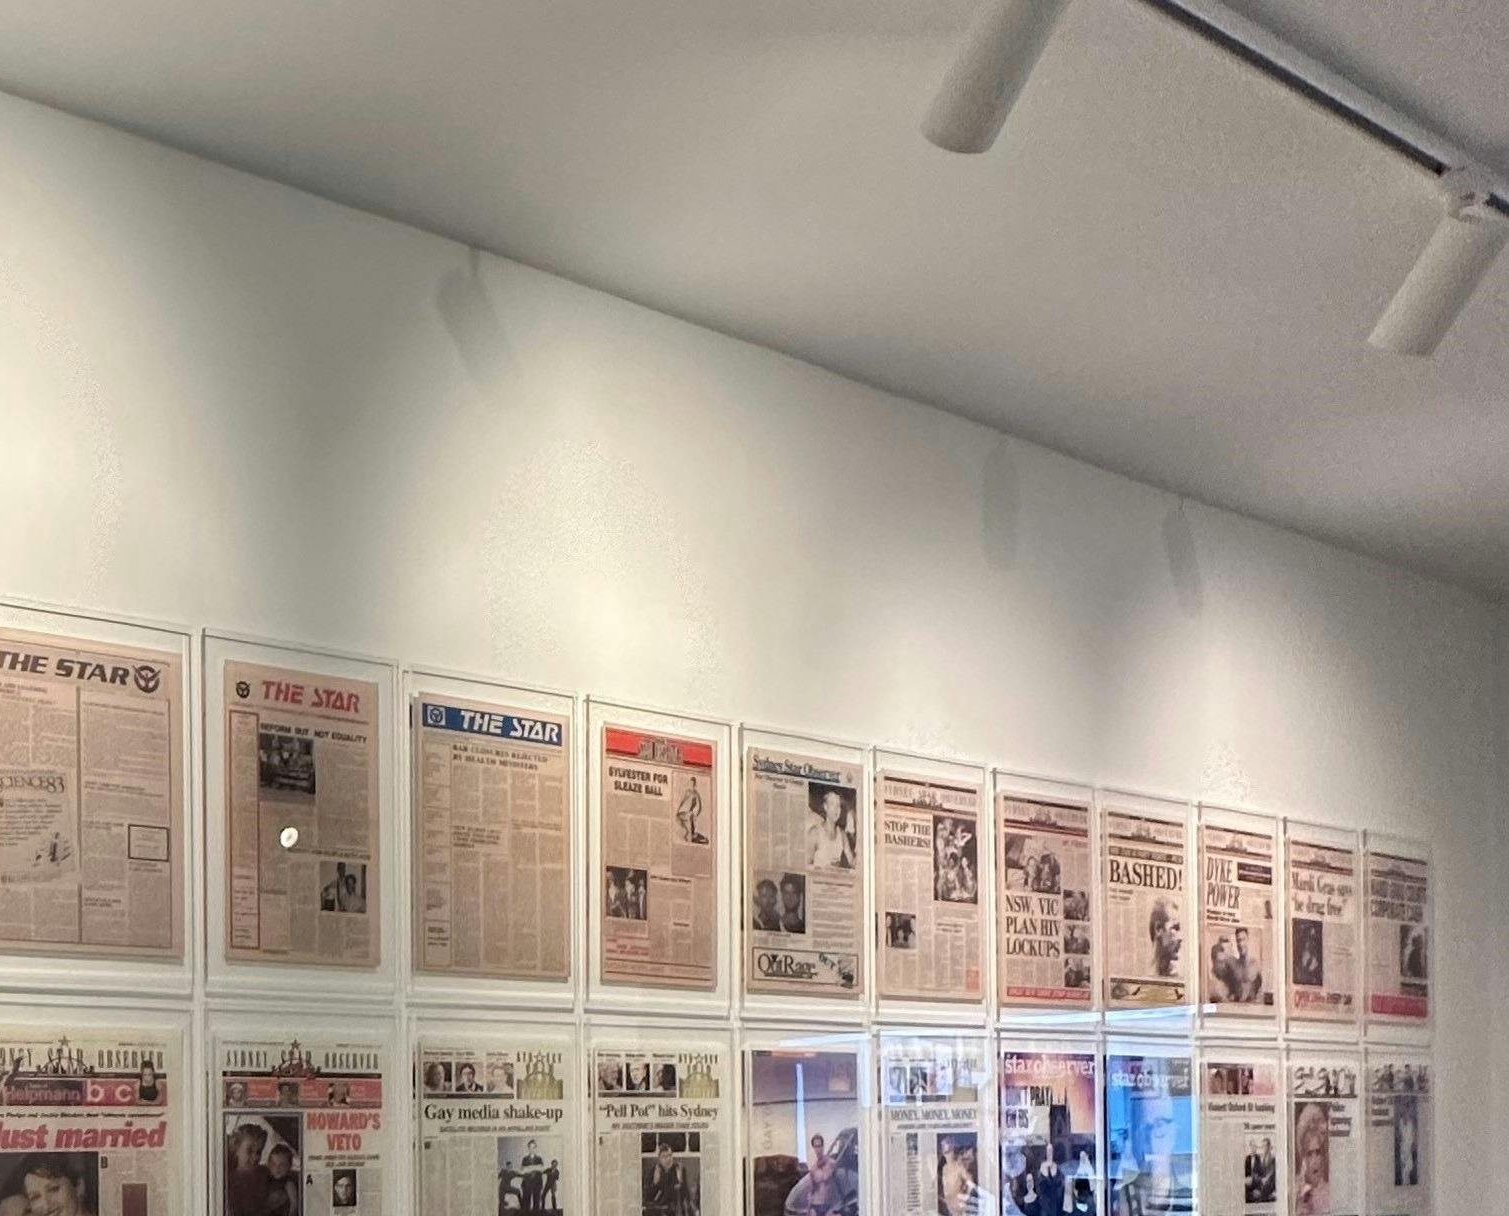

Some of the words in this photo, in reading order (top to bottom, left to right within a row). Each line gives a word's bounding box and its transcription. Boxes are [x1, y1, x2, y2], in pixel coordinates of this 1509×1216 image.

[54, 658, 130, 687] STAR
[262, 680, 304, 704] THE
[310, 687, 361, 713] STAR
[459, 709, 503, 732] THE
[511, 720, 559, 743] STAR
[314, 730, 329, 740] NOT
[331, 732, 368, 744] EQUALITY
[609, 766, 651, 781] SYLVESTER
[653, 773, 668, 785] FOR
[614, 780, 642, 793] SLEAZE
[645, 785, 663, 797] BALL
[884, 820, 909, 832] STOP
[911, 823, 931, 835] THE
[1109, 859, 1183, 891] BASHED!
[1206, 856, 1232, 882] DYKE
[1005, 894, 1034, 916] NSW,
[1039, 897, 1059, 916] VIC
[1206, 882, 1240, 909] POWER
[1006, 916, 1037, 936] PLAN
[1040, 919, 1060, 937] HIV
[1006, 937, 1060, 958] LOCKUPS
[306, 1112, 381, 1131] HOWARD'S
[424, 1104, 452, 1123] Gay
[458, 1104, 501, 1120] media
[503, 1104, 564, 1123] shake-up
[658, 1104, 678, 1118] hits
[680, 1104, 719, 1121] Sydney
[55, 1121, 168, 1149] married
[326, 1133, 362, 1152] VETO
